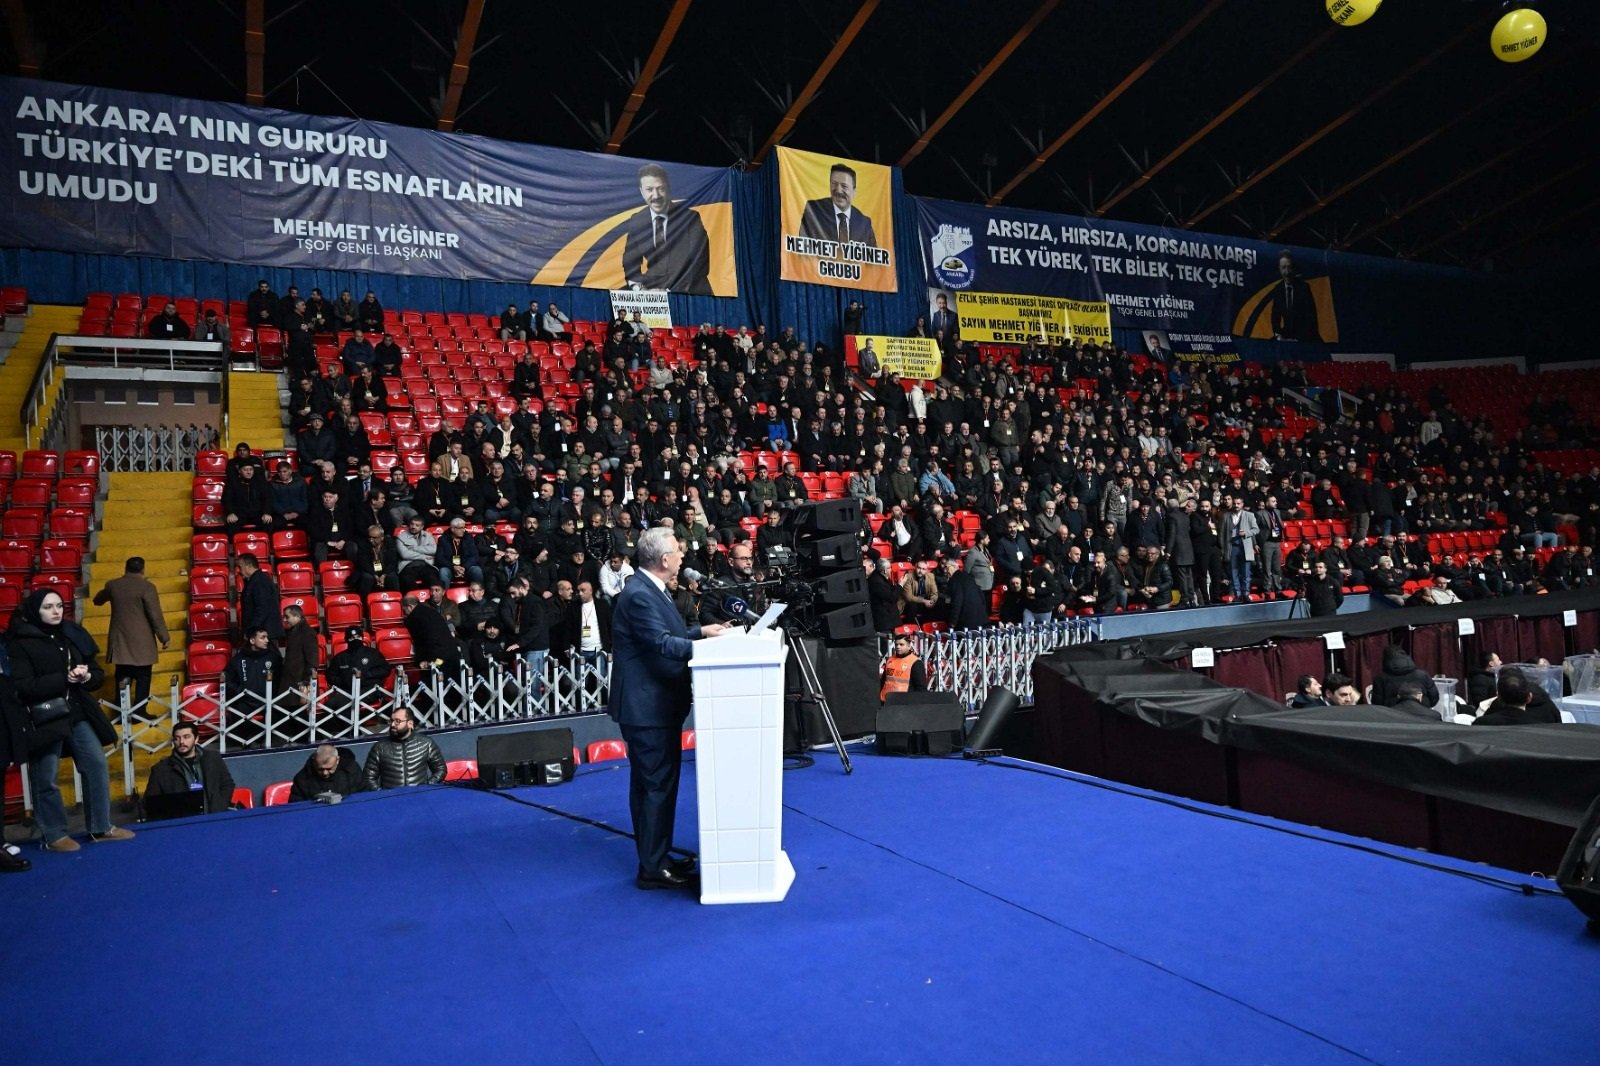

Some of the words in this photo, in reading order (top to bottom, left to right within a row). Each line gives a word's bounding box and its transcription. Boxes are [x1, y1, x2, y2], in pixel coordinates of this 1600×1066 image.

[1501, 42, 1519, 53] MEHMET
[16, 96, 250, 145] ANKARA’NIN
[258, 125, 388, 160] GURURU
[19, 170, 158, 205] UMUDU
[269, 157, 340, 188] TÜM
[347, 169, 523, 208] ESNAFLARIN
[273, 218, 370, 241] MEHMET
[375, 223, 460, 249] YİĞİNER
[987, 218, 1058, 245] ARSIZA,
[1061, 226, 1132, 253] HIRSIZA,
[1136, 234, 1212, 261] KORSANA
[1214, 245, 1257, 269] KARŞI
[296, 238, 335, 254] TŞOF
[337, 241, 380, 256] GENEL
[383, 245, 442, 261] BAŞKANI
[786, 235, 838, 258] MEHMET
[841, 240, 890, 265] YİĞİNER
[819, 260, 861, 280] GRUBU
[987, 246, 1023, 266] TEK
[1025, 246, 1088, 274] YÜREK,
[1092, 256, 1122, 274] TEK
[1126, 255, 1174, 281] BİLEK,
[1176, 264, 1204, 283] TEK
[1206, 268, 1244, 288] ÇARE
[959, 293, 977, 304] ETLİK
[979, 294, 999, 306] ŞEHİR
[1001, 296, 1037, 307] HASTANESİ
[1105, 293, 1150, 308] MEHMET
[1152, 293, 1195, 311] YİĞİNER
[1117, 306, 1133, 317] TŞOF
[1134, 308, 1157, 318] GENEL
[1158, 310, 1188, 320] BAŞKANI
[961, 317, 986, 329] SAYIN
[989, 318, 1025, 331] MEHMET
[1073, 323, 1109, 337] EKİBİYLE
